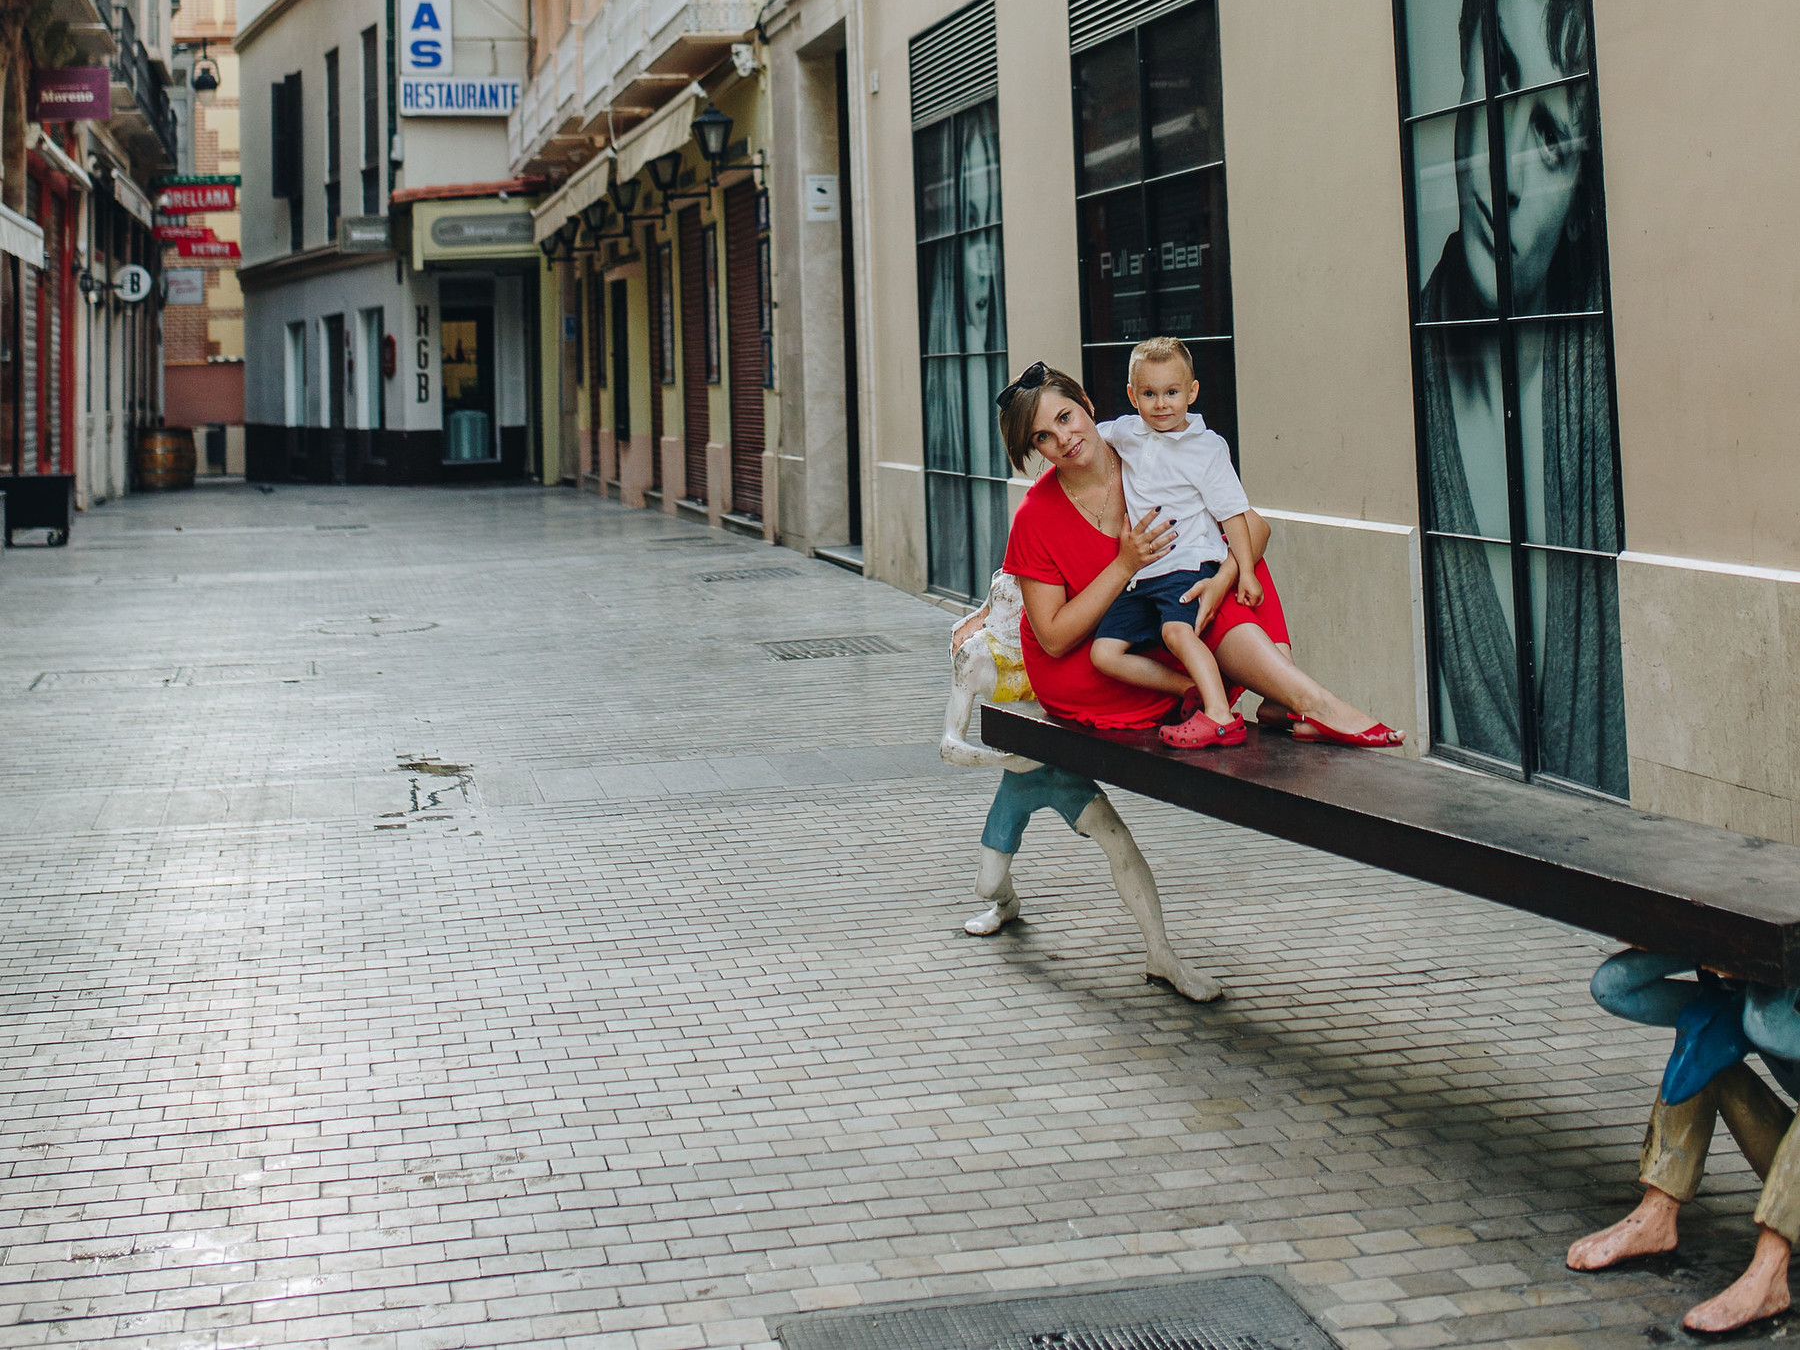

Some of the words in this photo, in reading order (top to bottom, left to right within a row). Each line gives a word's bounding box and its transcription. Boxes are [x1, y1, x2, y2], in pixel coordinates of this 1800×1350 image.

[41, 90, 94, 103] Moreno
[403, 82, 520, 109] RESTAURANTE
[1161, 242, 1210, 270] Bear
